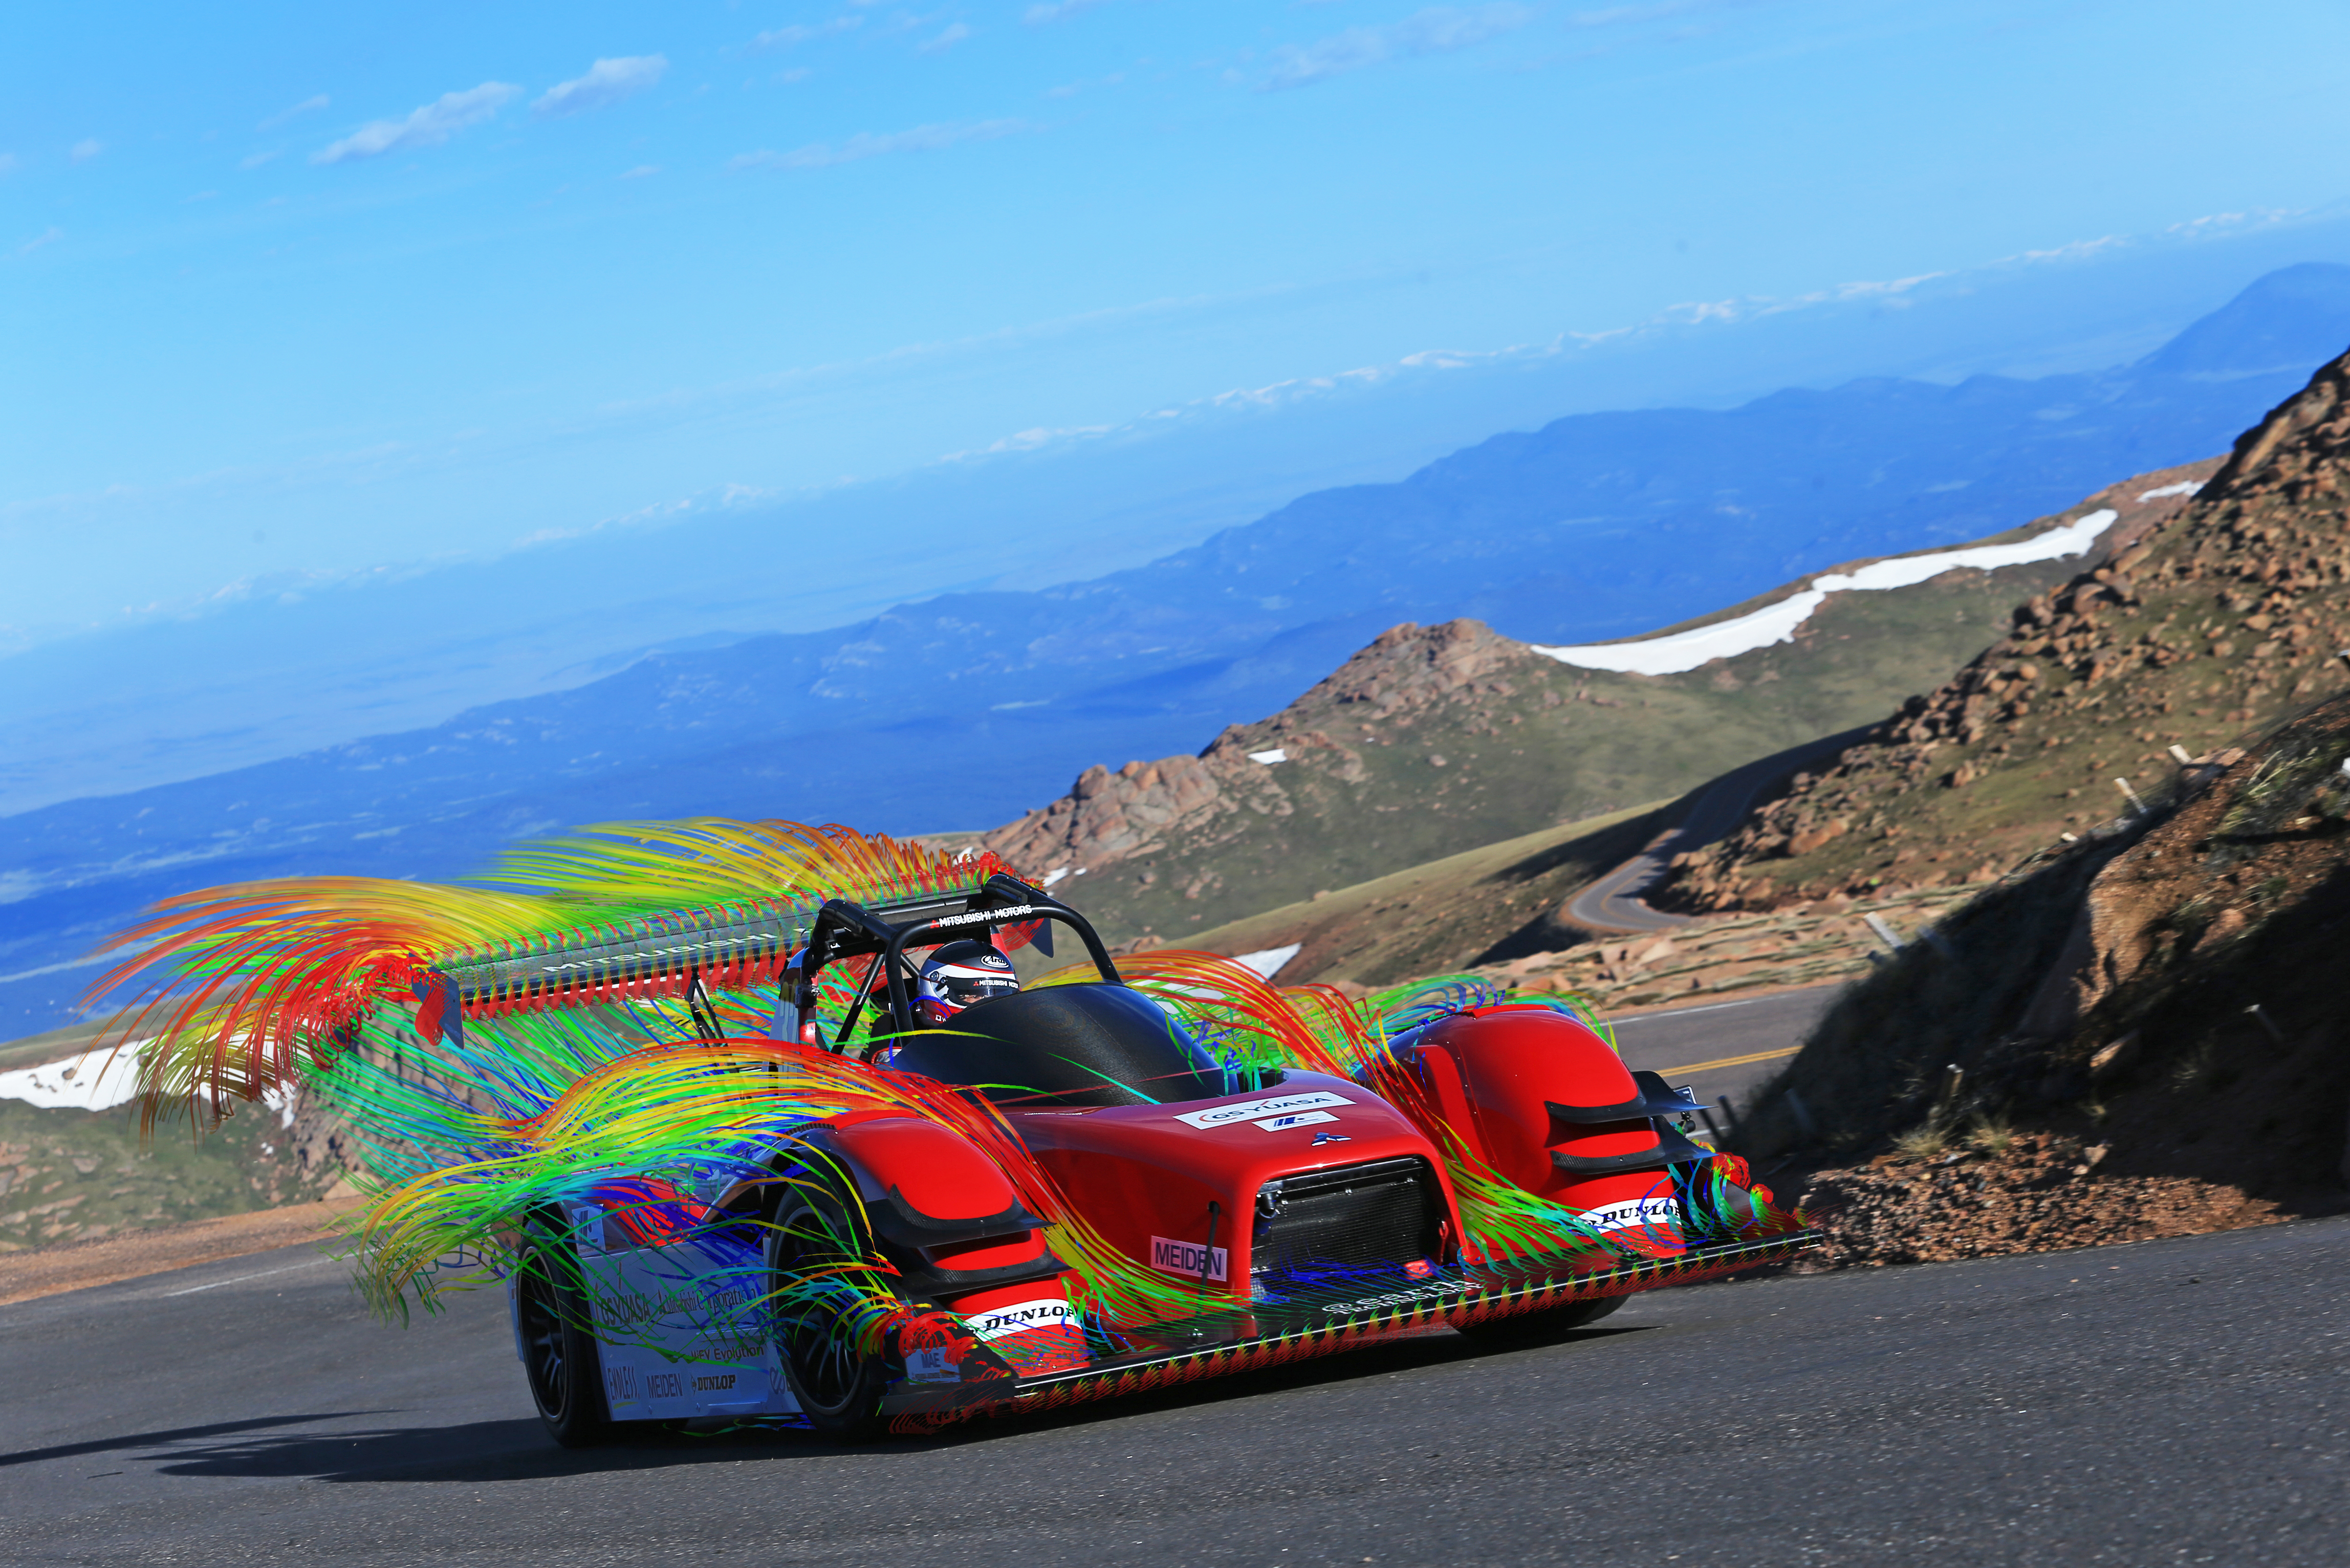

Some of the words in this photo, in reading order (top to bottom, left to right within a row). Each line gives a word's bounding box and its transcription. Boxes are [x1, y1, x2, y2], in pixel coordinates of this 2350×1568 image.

[939, 910, 991, 927] MITSUBISHI
[994, 904, 1032, 919] MOTORS
[541, 933, 778, 972] MITSUBISHI
[1243, 1097, 1333, 1112] YUASA
[1156, 1242, 1222, 1276] MEIDEN
[984, 1306, 1075, 1332] DUNLOP
[713, 1344, 765, 1361] Evolution
[607, 1366, 637, 1400] ENDLESS
[646, 1373, 683, 1399] MEIDEN
[697, 1374, 736, 1391] DUNLOP
